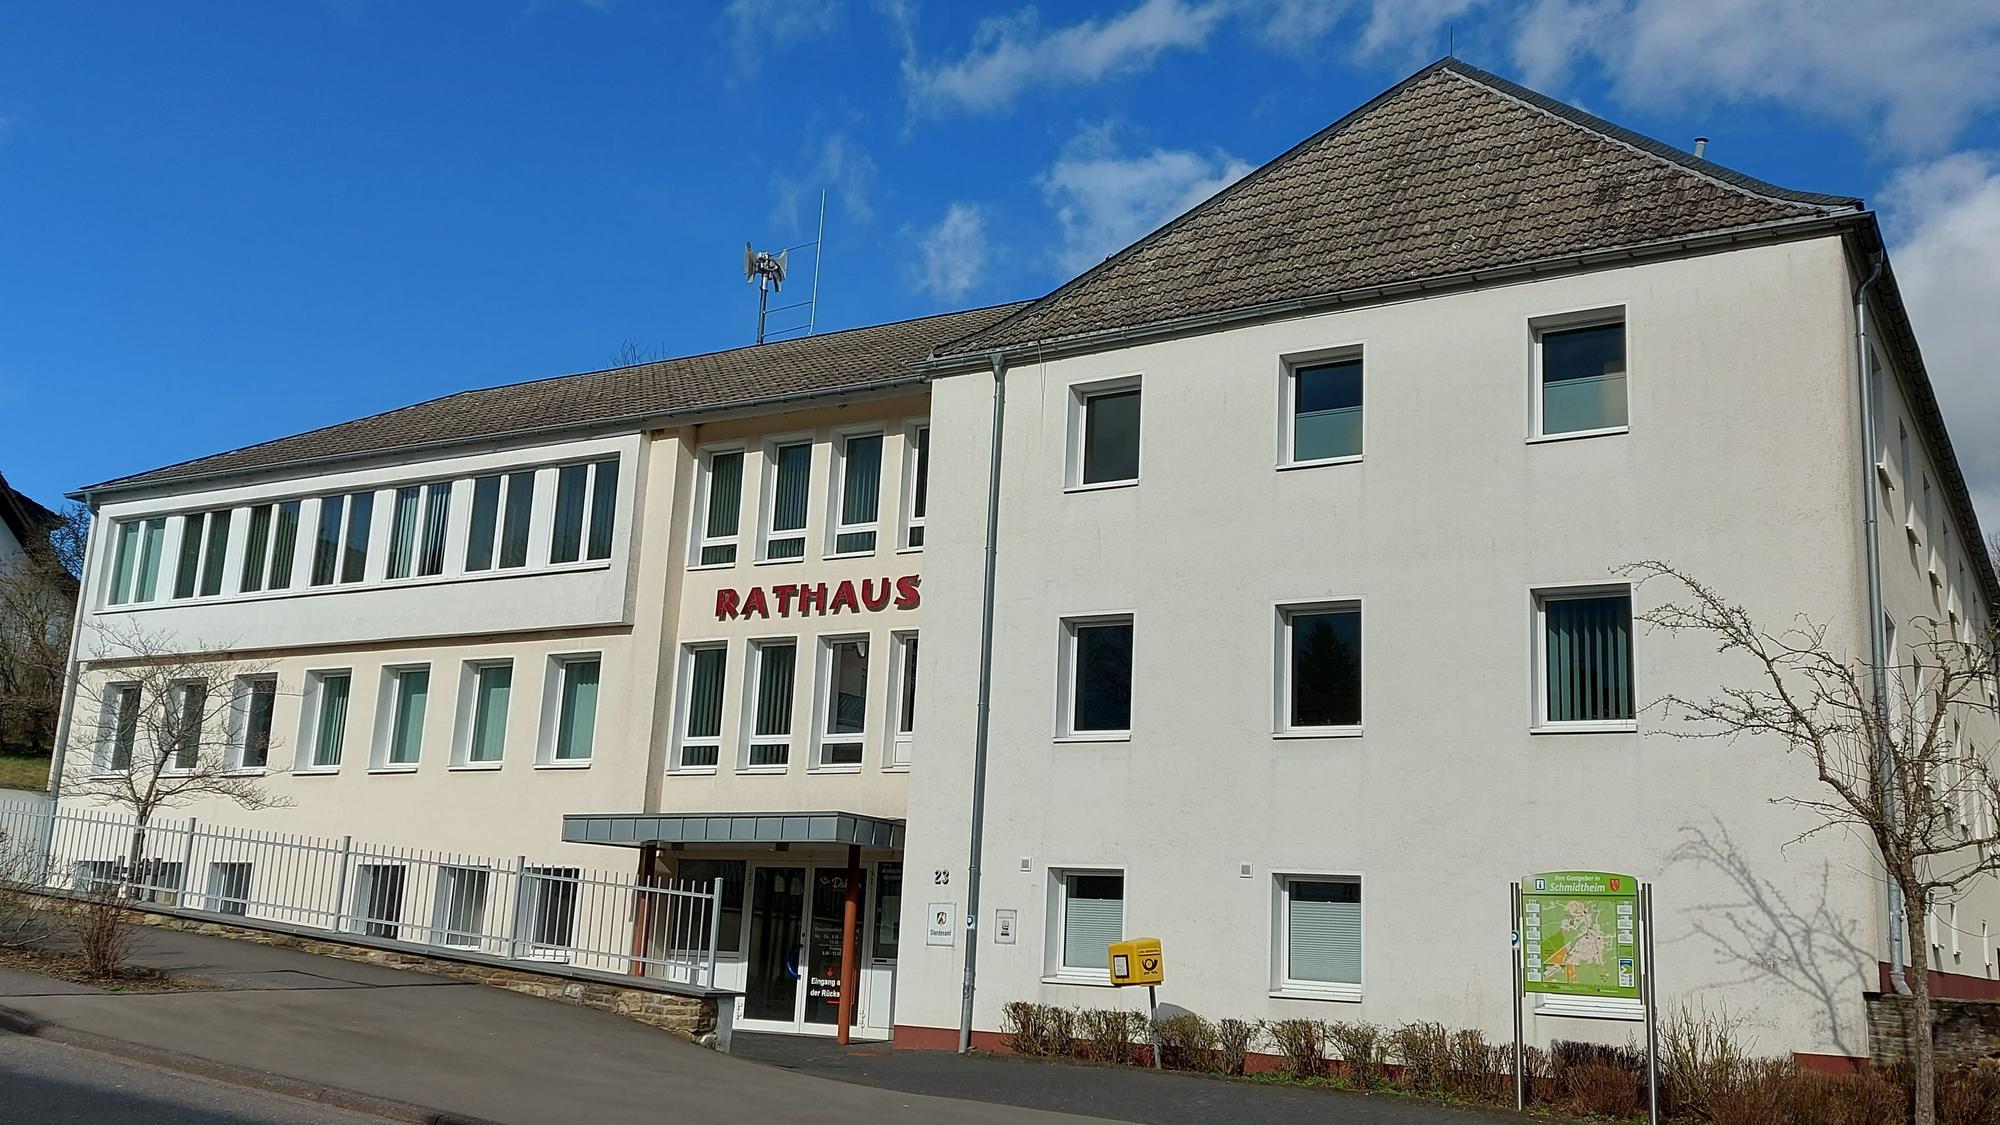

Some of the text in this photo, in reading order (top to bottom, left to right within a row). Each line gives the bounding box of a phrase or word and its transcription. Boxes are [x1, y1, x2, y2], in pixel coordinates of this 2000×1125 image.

[715, 574, 922, 621] RATHAUS
[934, 870, 950, 885] 23
[1550, 883, 1605, 892] Schmidtheim
[811, 977, 836, 987] Eingang
[810, 988, 841, 998] der Rücks
